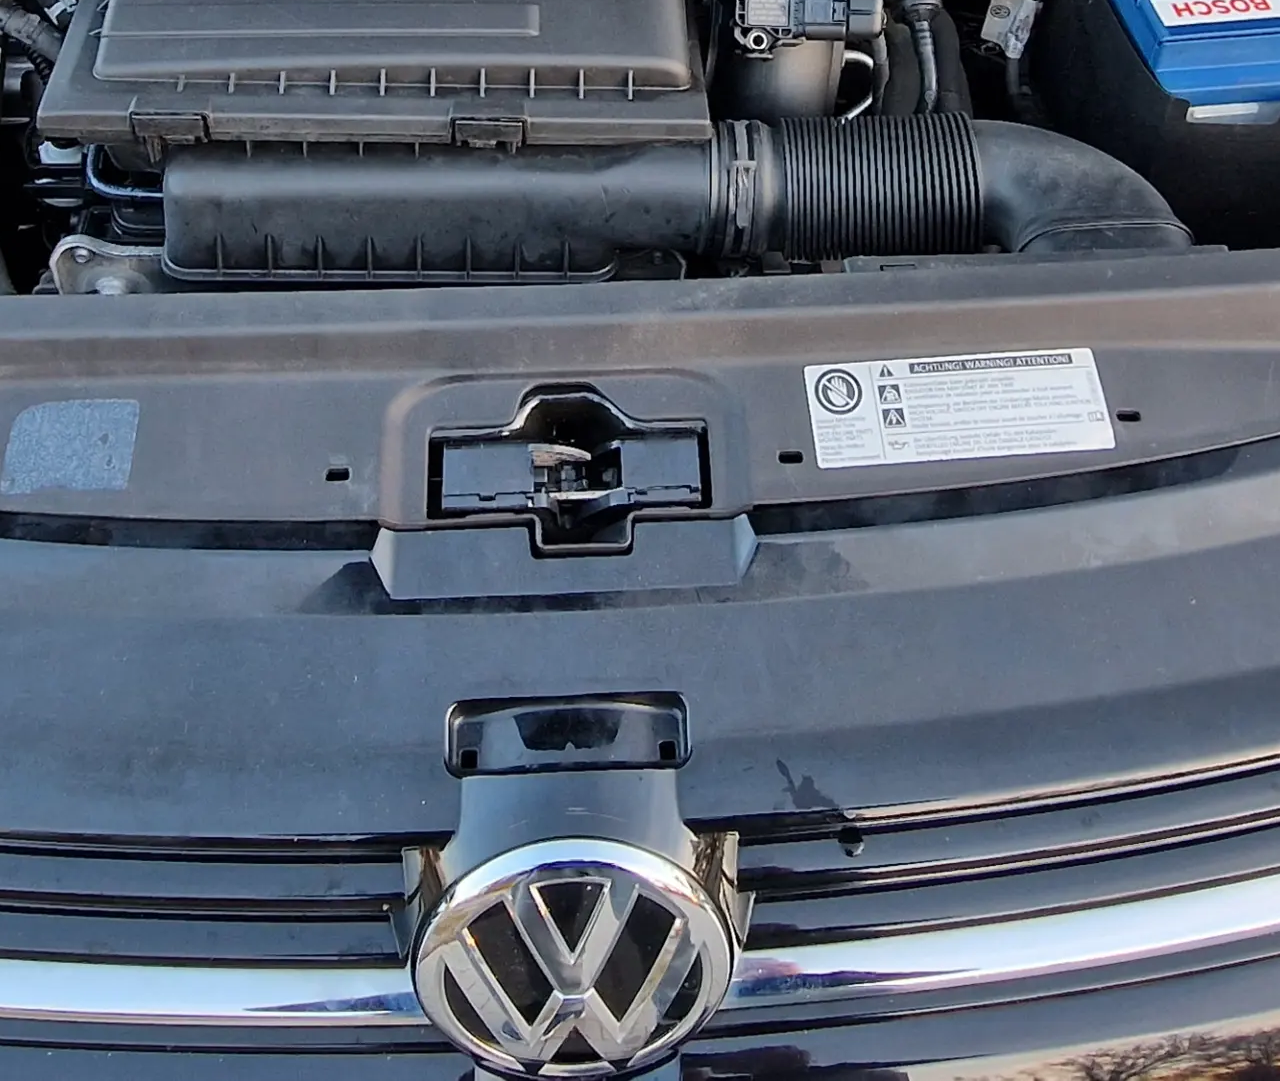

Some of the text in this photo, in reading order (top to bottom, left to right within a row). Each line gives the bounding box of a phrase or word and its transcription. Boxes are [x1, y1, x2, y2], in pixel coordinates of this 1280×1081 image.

[913, 354, 1070, 373] ACHTUNG! WARNING! ATTENTION!
[426, 861, 720, 1072] VW
